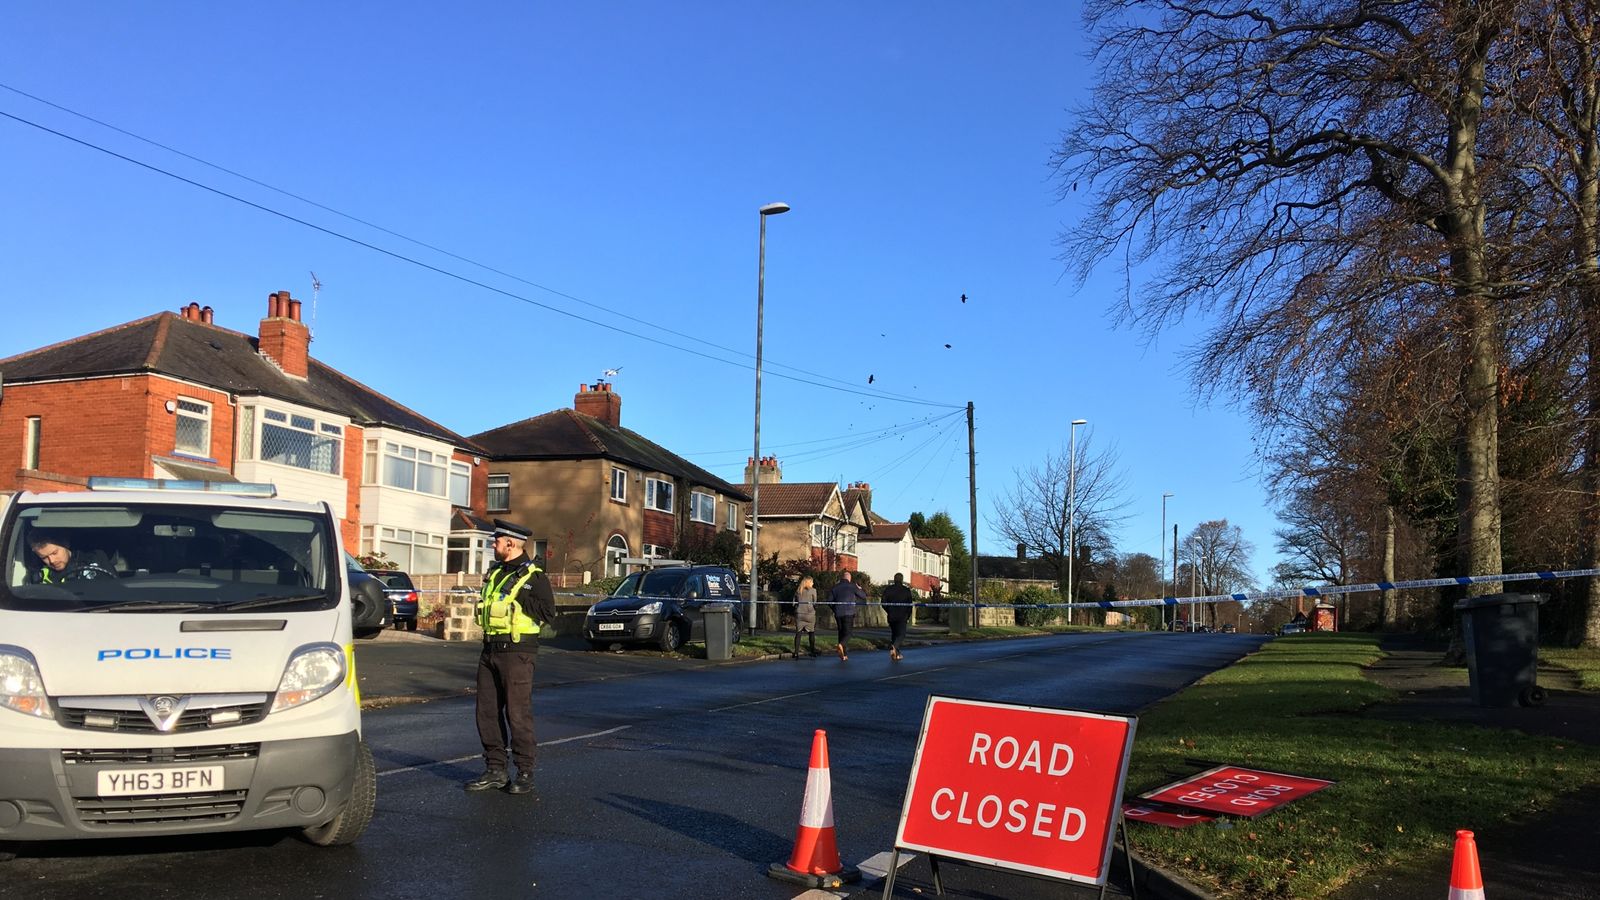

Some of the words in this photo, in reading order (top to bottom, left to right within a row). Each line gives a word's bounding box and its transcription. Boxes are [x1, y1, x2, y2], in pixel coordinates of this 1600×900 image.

[97, 647, 232, 661] POLICE
[968, 732, 1074, 777] ROAD
[107, 772, 164, 791] YH63
[172, 769, 213, 788] BFN
[1177, 774, 1260, 803] CLOSED
[1230, 784, 1294, 806] ROAD
[930, 787, 1087, 842] CLOSED
